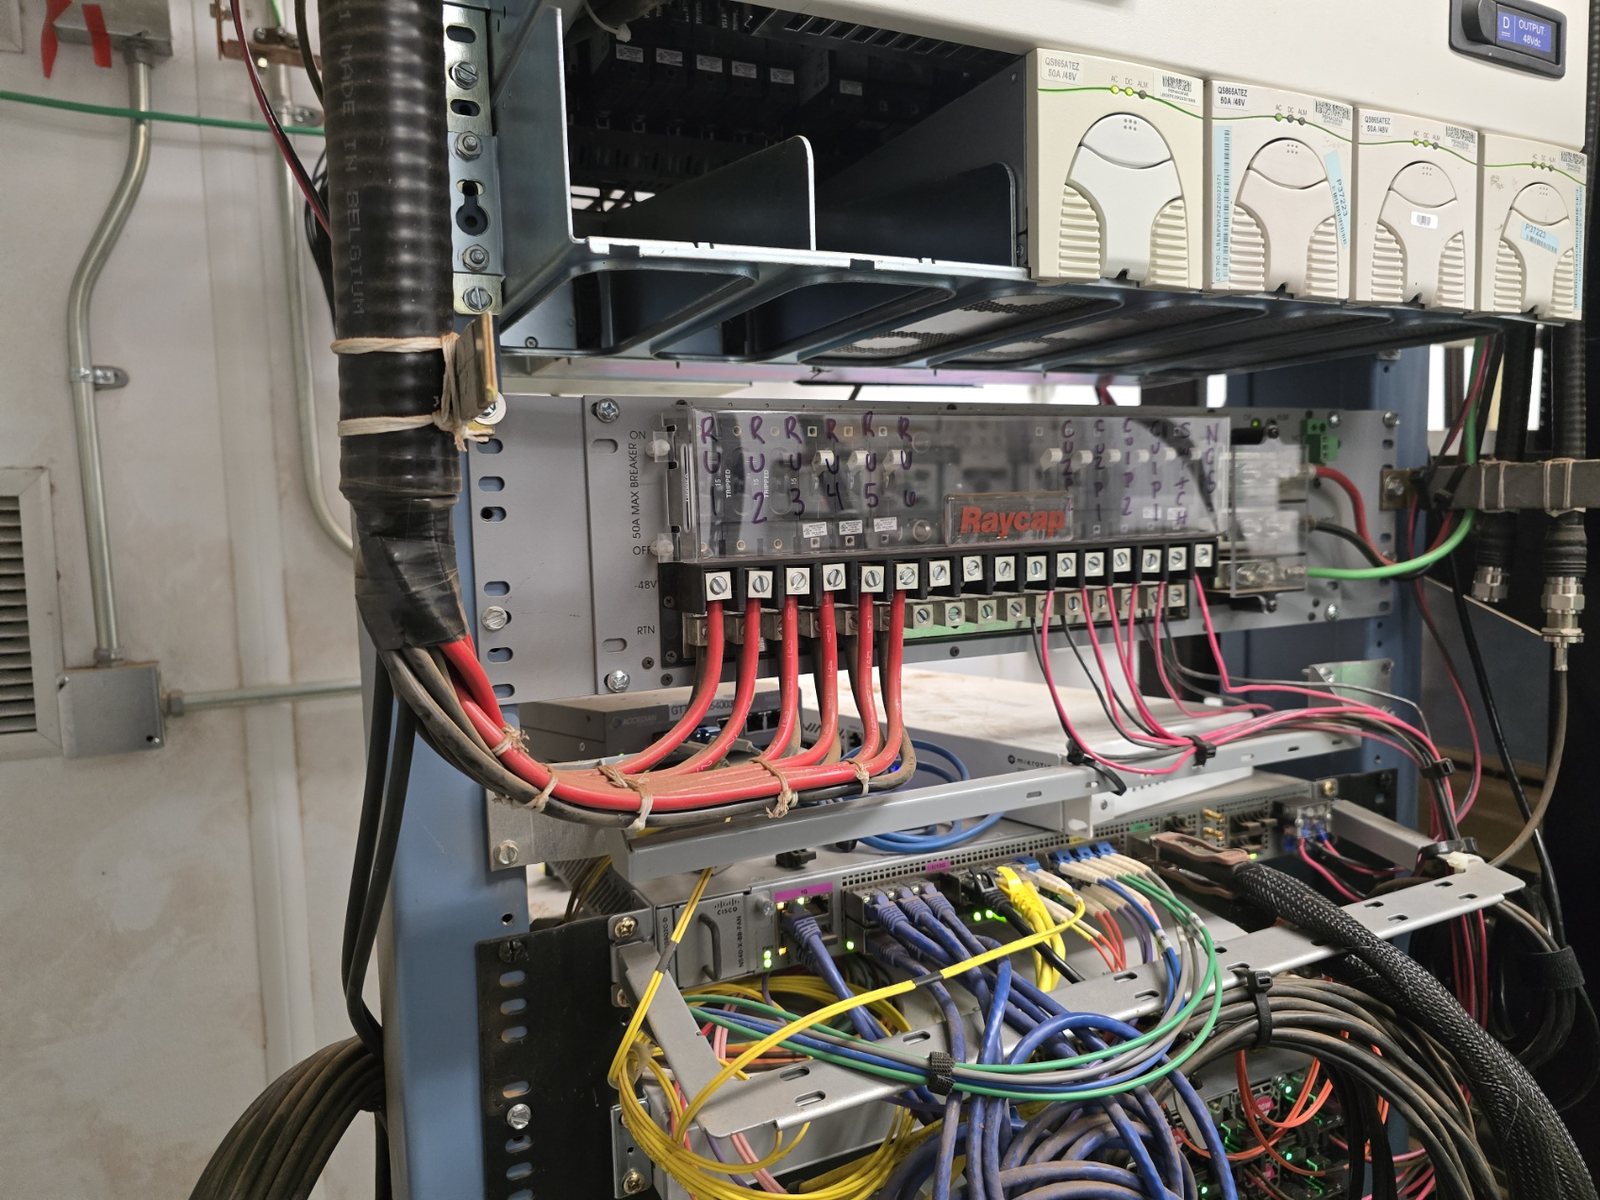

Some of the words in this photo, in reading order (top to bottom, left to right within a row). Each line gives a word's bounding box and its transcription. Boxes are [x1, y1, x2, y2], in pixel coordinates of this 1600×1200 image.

[1503, 16, 1510, 29] D
[1518, 19, 1544, 36] OUTPUT
[1522, 34, 1542, 48] 48Vdc
[1110, 75, 1118, 83] AC
[1125, 77, 1133, 86] DC
[338, 44, 356, 117] MADE
[347, 190, 365, 315] BELGIUM
[629, 430, 647, 440] ON
[628, 443, 640, 489] BREAKER
[725, 468, 733, 499] TRIPPED
[630, 491, 641, 516] MAX
[631, 519, 642, 540] 50A
[961, 506, 1065, 540] Raycap
[634, 580, 657, 590] -48V
[637, 625, 656, 636] RTN
[716, 906, 738, 916] CISCO
